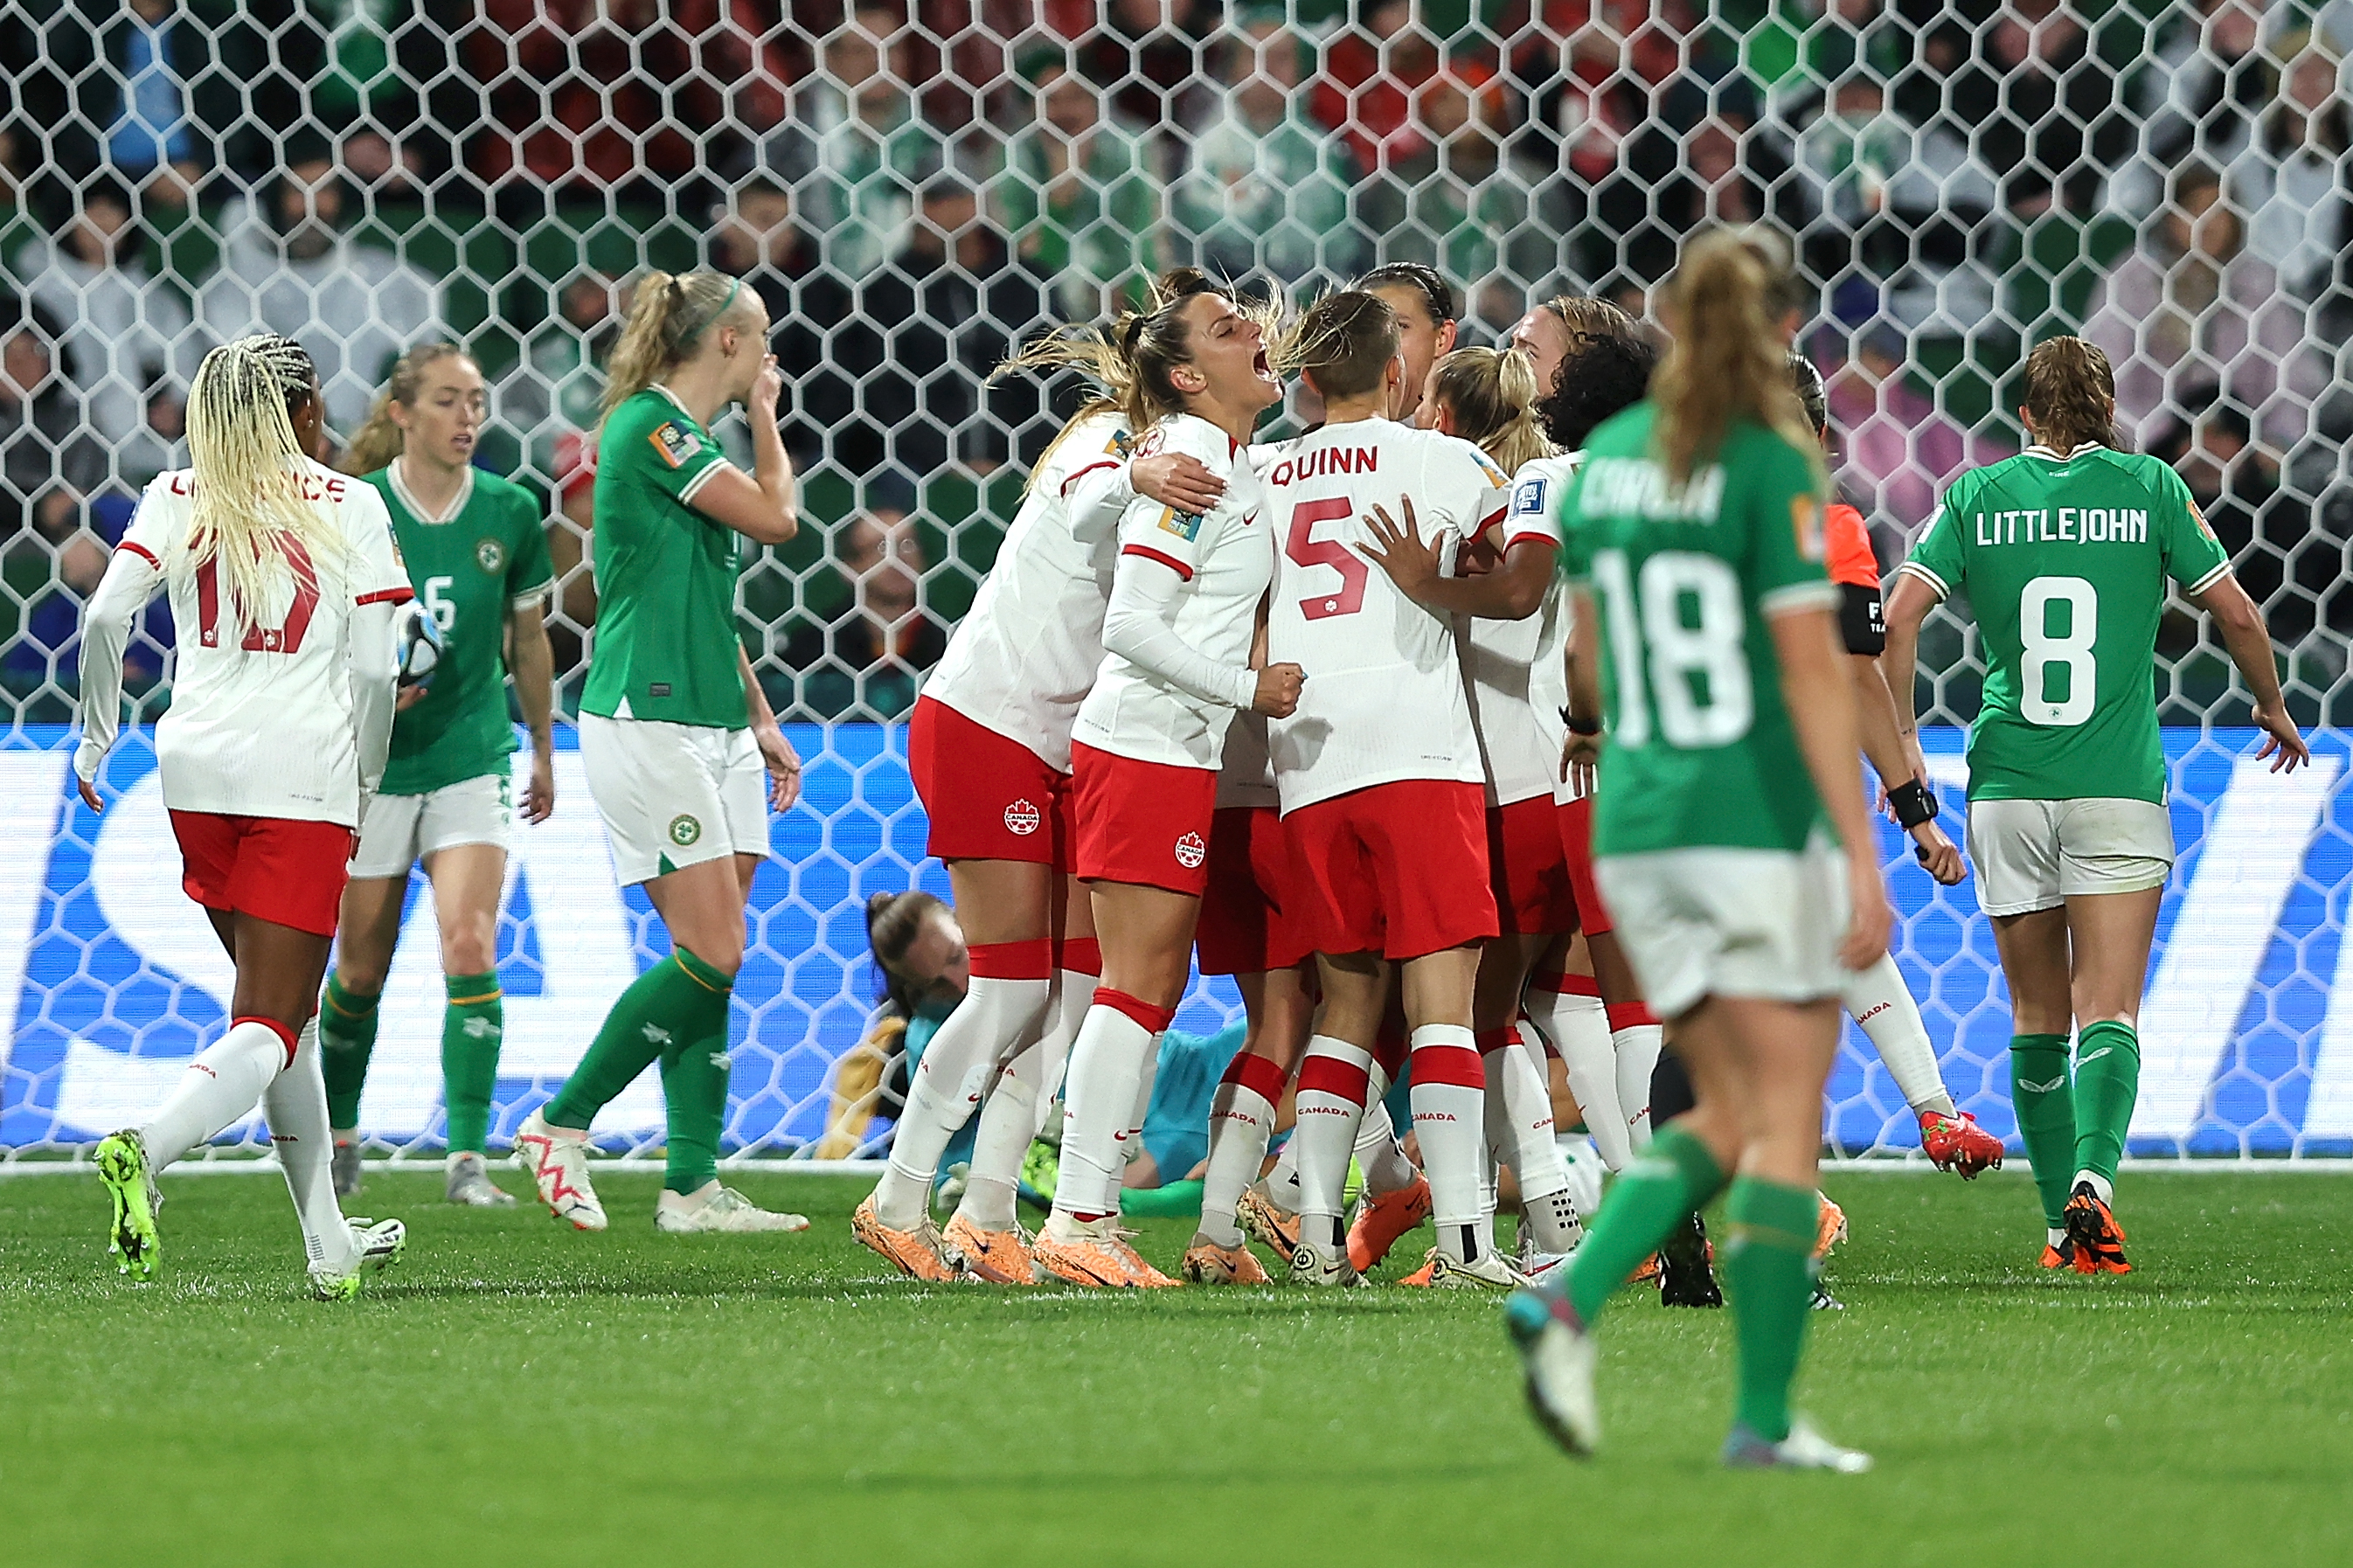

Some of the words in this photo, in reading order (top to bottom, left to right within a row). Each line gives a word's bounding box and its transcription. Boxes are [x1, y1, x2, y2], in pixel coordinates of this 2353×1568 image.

[1271, 445, 1378, 487] QUINN
[1976, 508, 2148, 545] LITTLEJOHN
[1285, 496, 1369, 621] 5
[423, 575, 457, 631] 6
[1593, 546, 1755, 750] 18
[2021, 576, 2097, 725] 8
[1176, 844, 1203, 856] CANADA
[1298, 1107, 1350, 1118] CANADA
